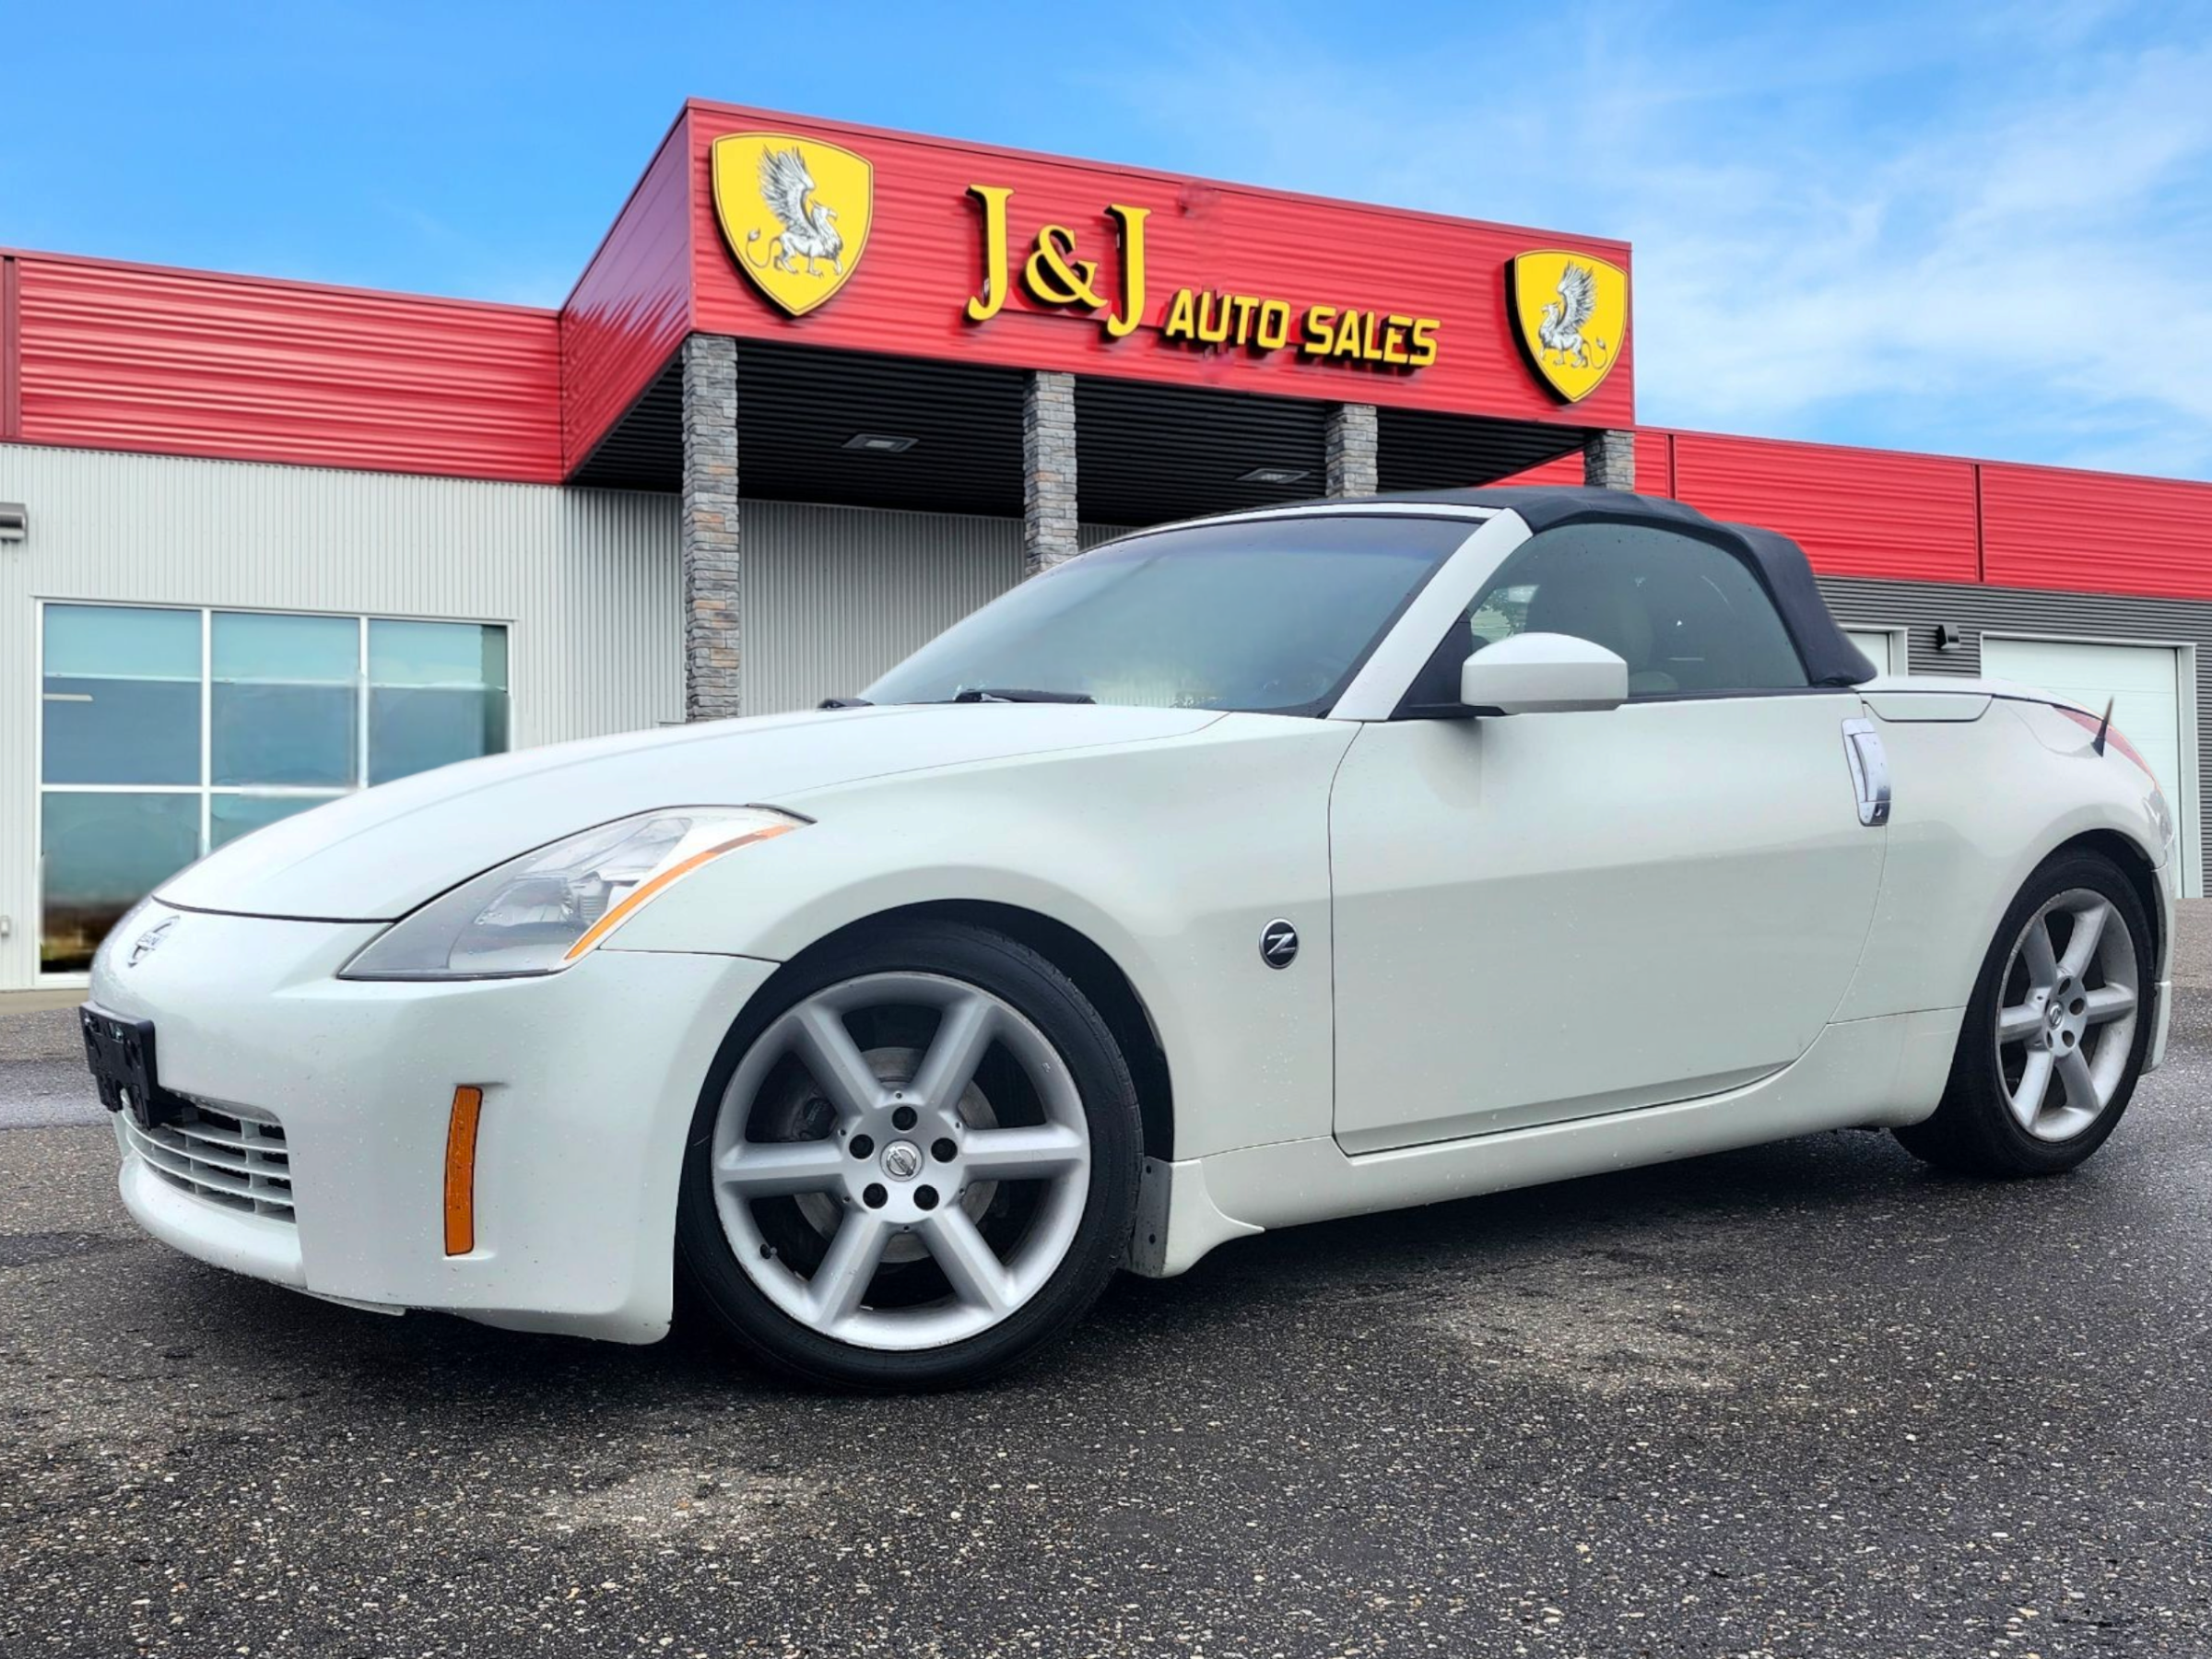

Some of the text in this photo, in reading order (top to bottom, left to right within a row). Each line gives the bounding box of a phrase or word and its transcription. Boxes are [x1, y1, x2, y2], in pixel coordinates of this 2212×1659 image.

[965, 184, 1151, 337] J&J
[1166, 288, 1441, 367] AUTO SALES
[1267, 932, 1296, 955] Z
